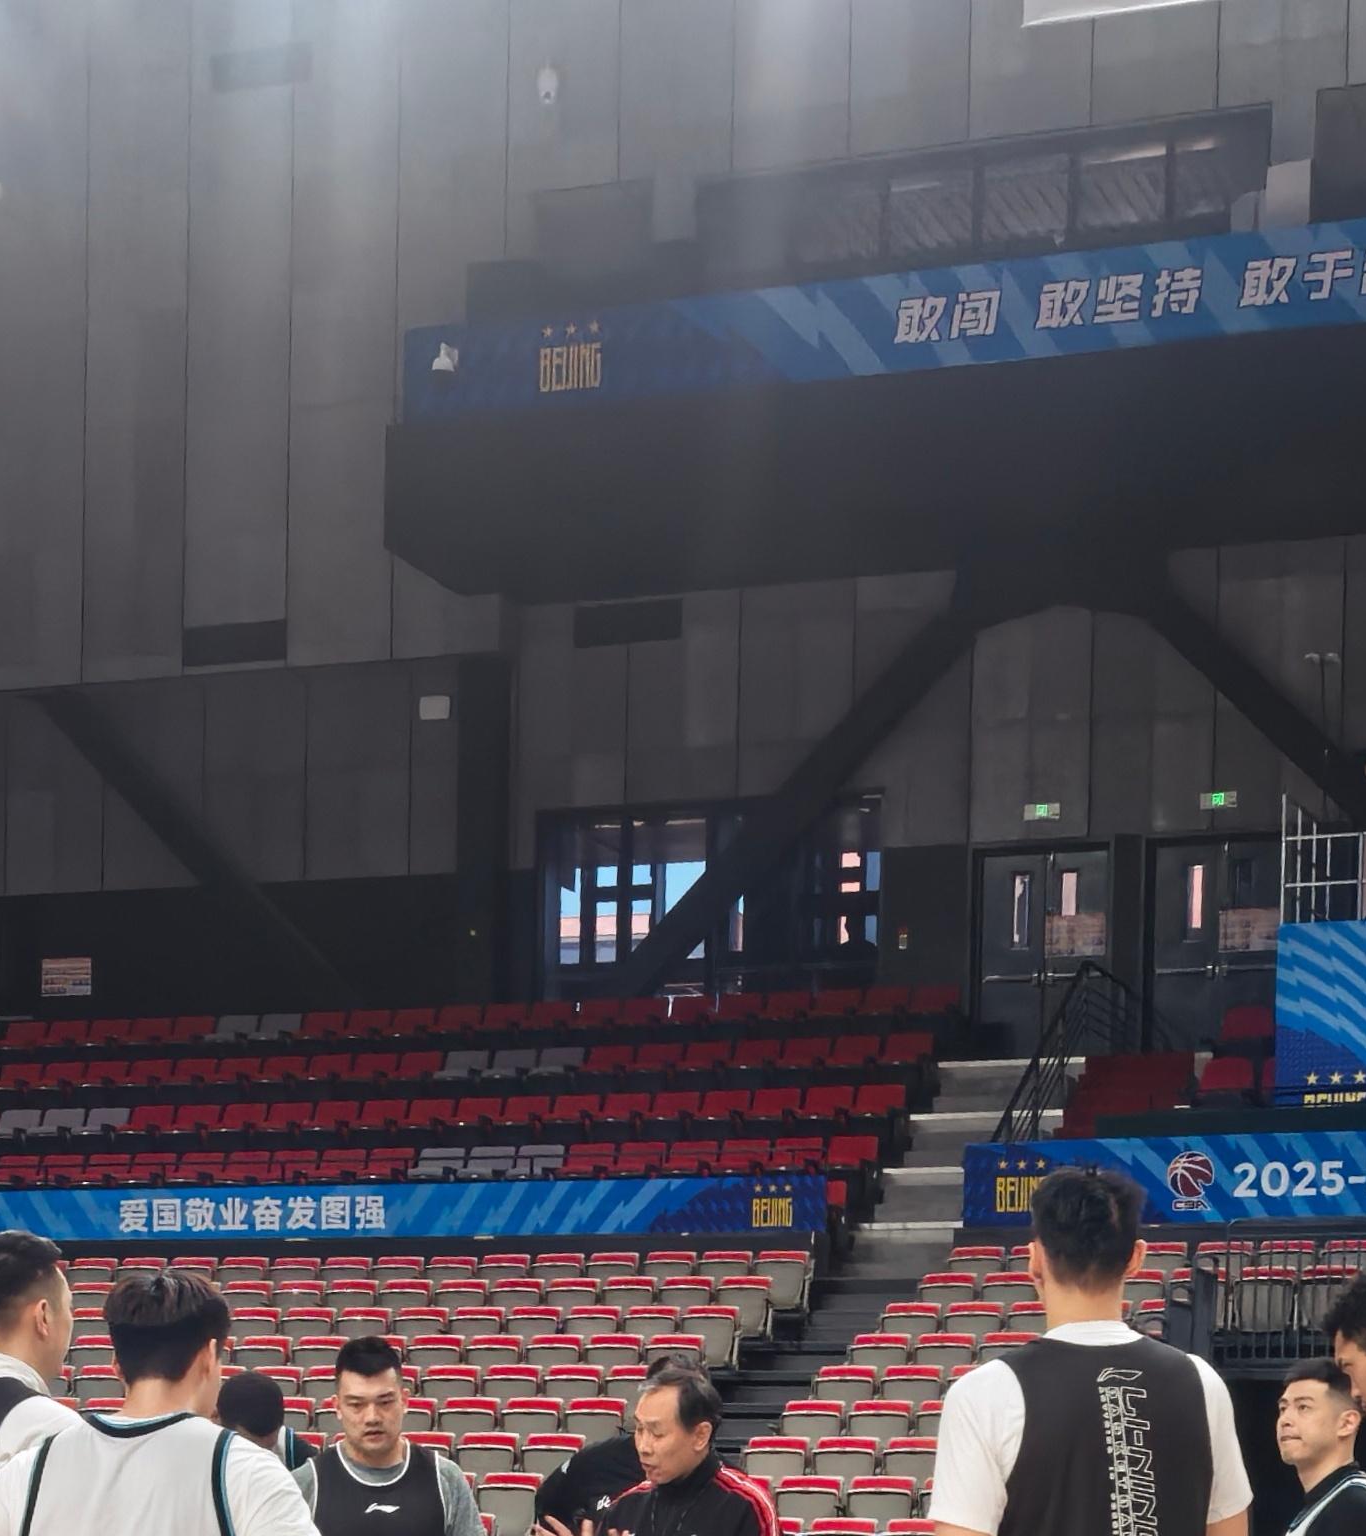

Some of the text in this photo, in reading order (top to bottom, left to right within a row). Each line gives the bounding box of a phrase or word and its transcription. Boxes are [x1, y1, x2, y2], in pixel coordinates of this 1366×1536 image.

[892, 289, 1001, 346] 敢闯
[1034, 266, 1203, 330] 敢坚持
[539, 342, 602, 392] BEIJING
[751, 1197, 793, 1228] BEIJING
[995, 1176, 1046, 1213] BEIJIN
[118, 1195, 386, 1232] 爱国敬业奋发图强
